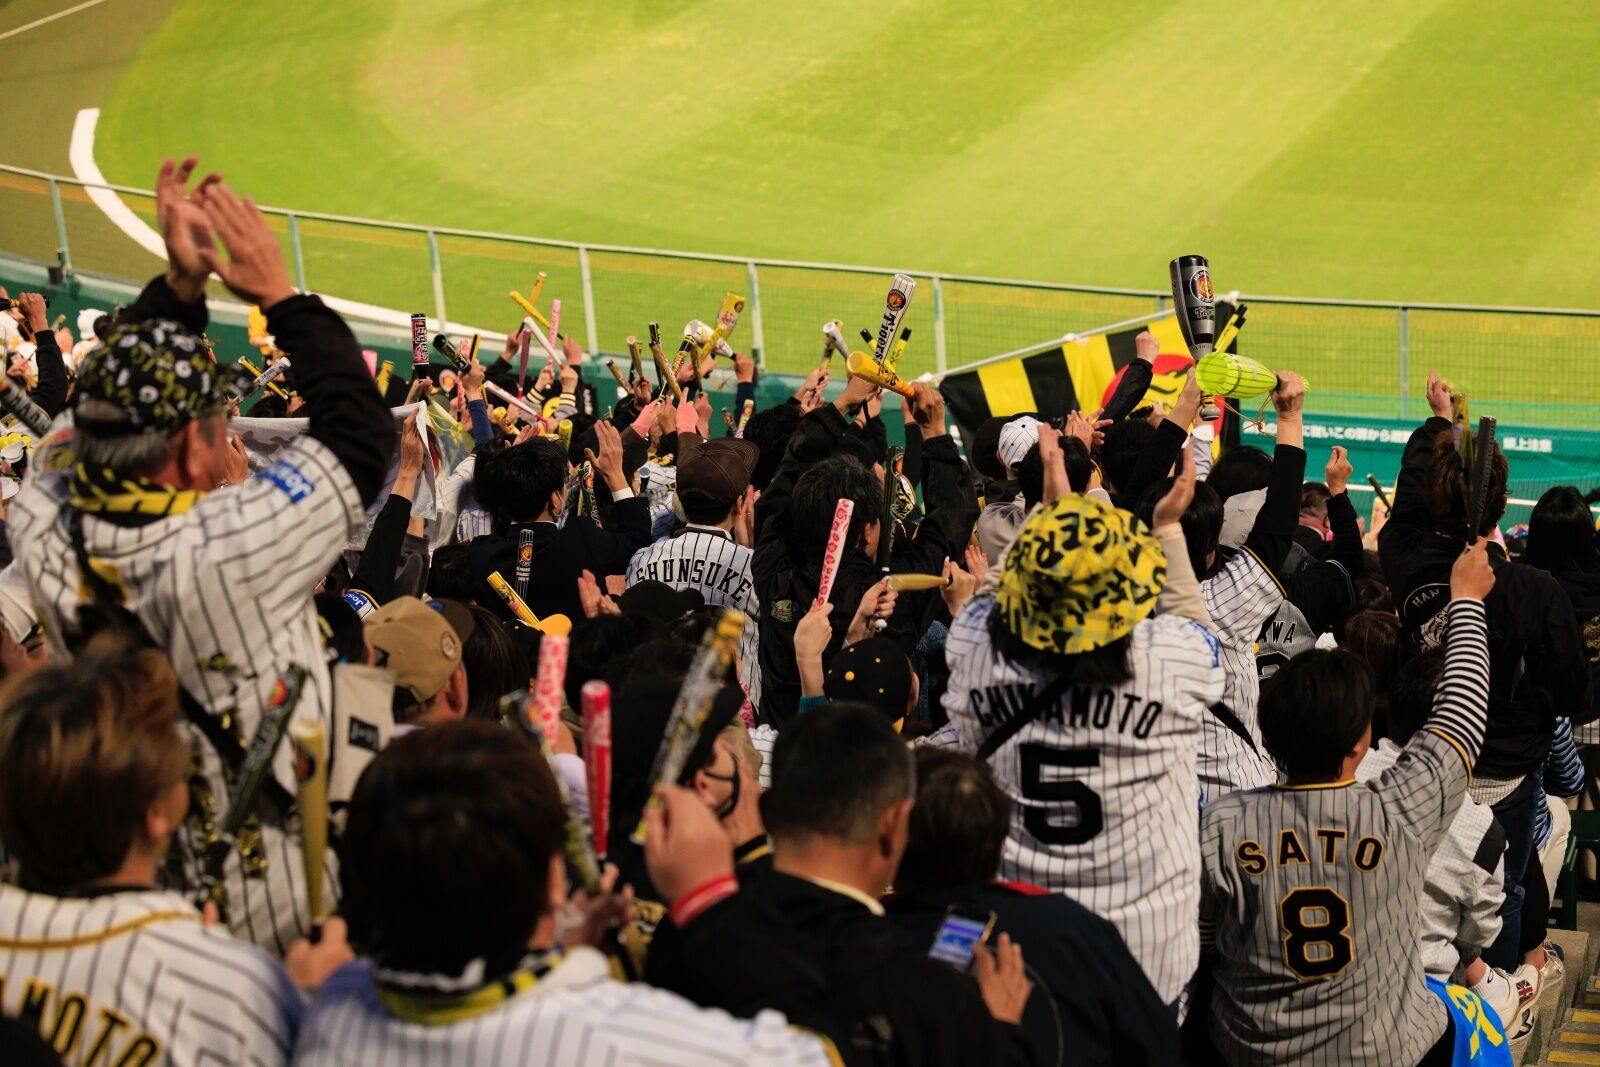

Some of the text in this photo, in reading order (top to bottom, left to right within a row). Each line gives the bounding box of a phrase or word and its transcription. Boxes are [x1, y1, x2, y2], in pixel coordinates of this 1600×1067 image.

[636, 558, 752, 602] SHUNSUKE
[1019, 742, 1104, 846] 5
[1235, 828, 1385, 877] SATO
[1279, 886, 1355, 981] 8
[0, 974, 165, 1067] MOTO
